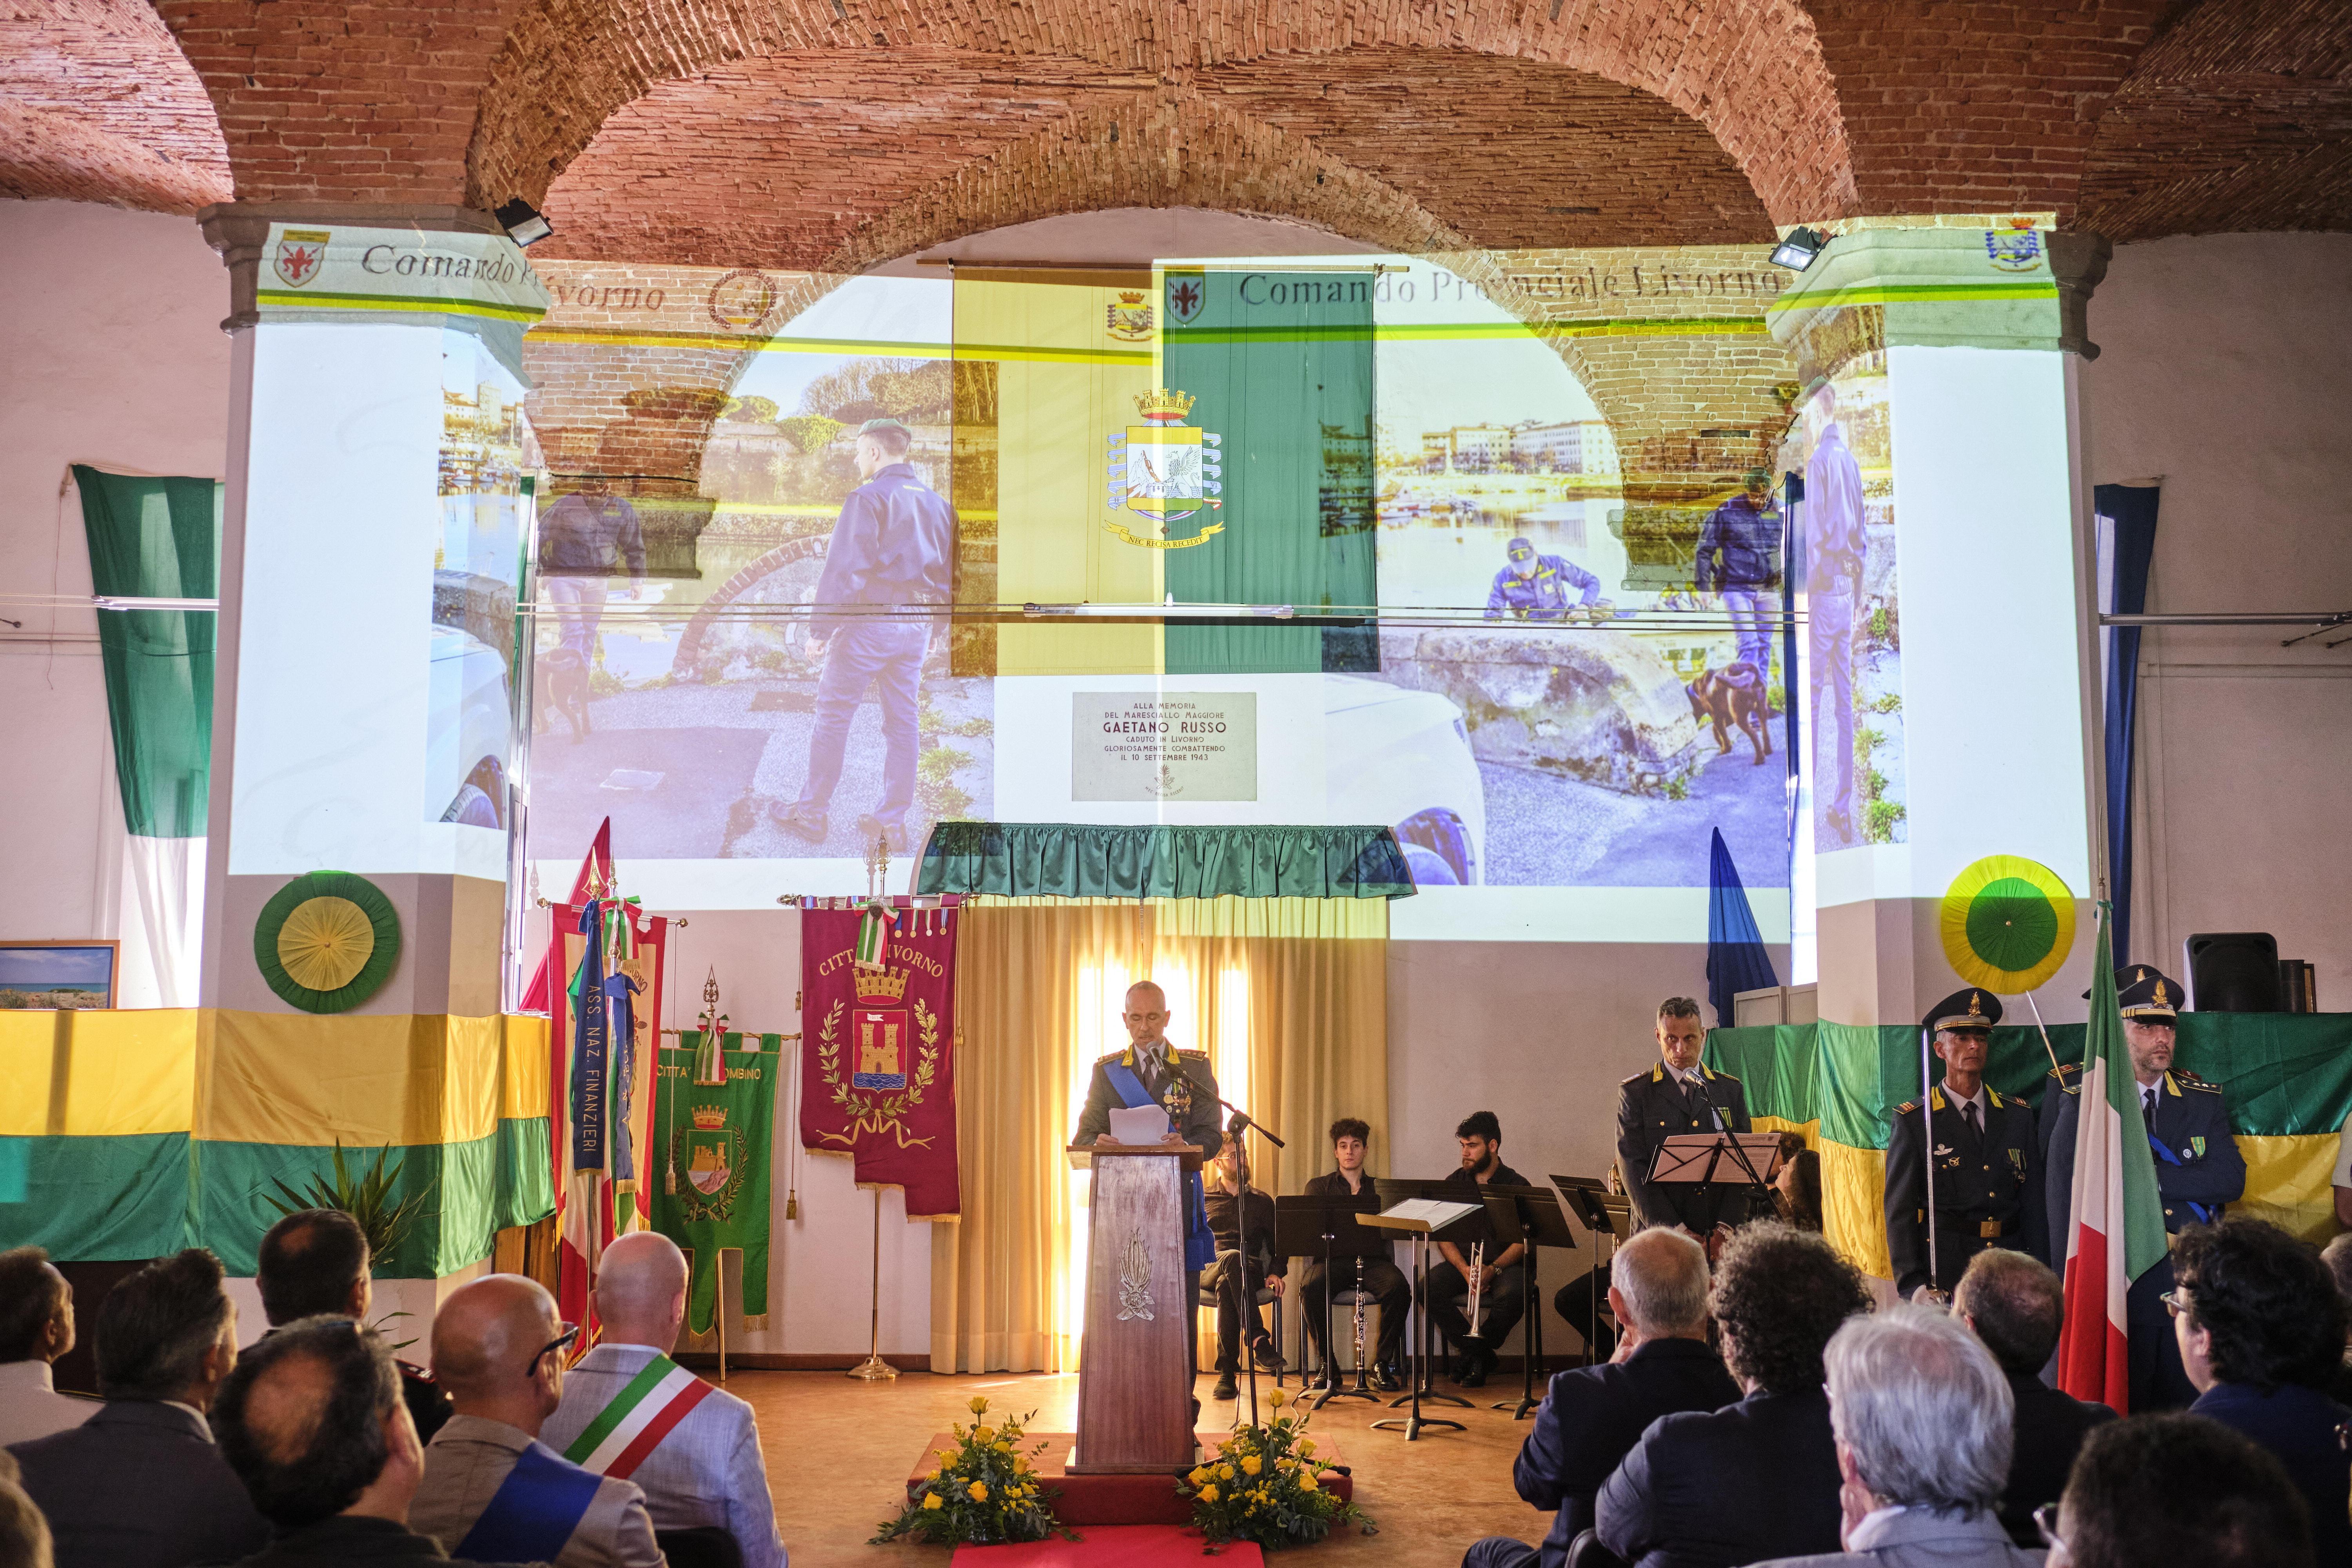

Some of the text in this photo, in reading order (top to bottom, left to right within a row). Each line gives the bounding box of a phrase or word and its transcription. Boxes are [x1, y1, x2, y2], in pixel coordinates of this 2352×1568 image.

[362, 245, 514, 283] Comando
[1240, 265, 1779, 305] Comando Provinciale Livorno
[1128, 536, 1144, 545] NEC
[1173, 536, 1203, 548] RECEDIT
[1103, 722, 1226, 733] GAETANO RUSSO
[820, 944, 943, 977] CITT IVORNO
[583, 985, 601, 1151] ASS. NAZ. FINANZIERI
